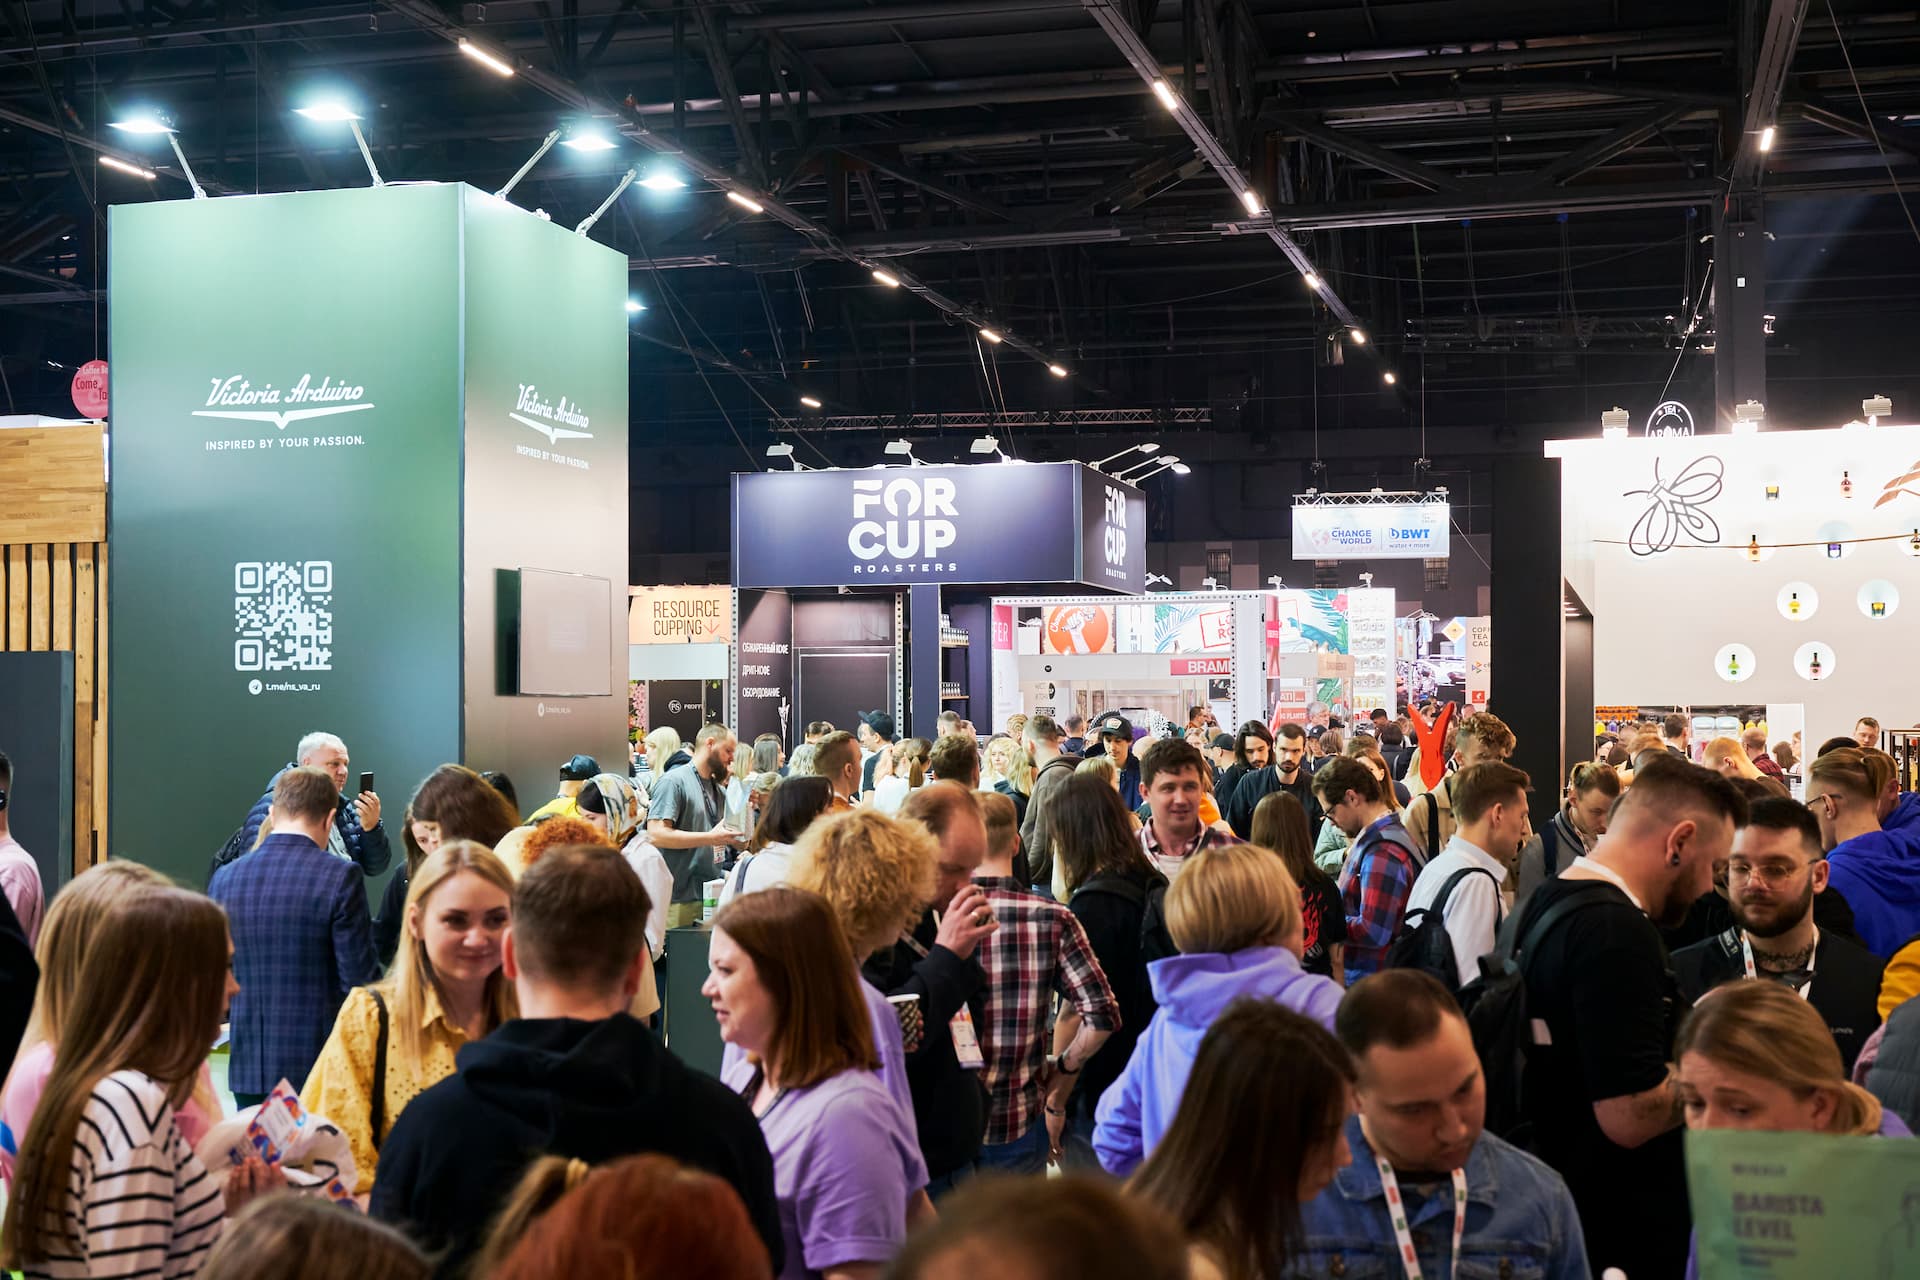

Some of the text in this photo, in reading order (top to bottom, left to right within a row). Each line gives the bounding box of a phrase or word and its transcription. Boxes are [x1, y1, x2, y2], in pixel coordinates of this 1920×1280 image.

[75, 378, 98, 390] Come
[205, 373, 364, 407] Victoria Arduino
[516, 383, 589, 429] Victoria Arduino
[205, 435, 365, 451] INSPIRED BY YOUR PASSION.
[516, 445, 541, 459] INSPIRED
[853, 477, 960, 519] FOR
[1105, 484, 1127, 529] FOR
[847, 519, 957, 560] CUP
[1332, 529, 1372, 538] CHANGE
[1340, 537, 1372, 545] WORLD
[1401, 528, 1430, 539] BWT
[1104, 525, 1127, 567] CUP
[853, 563, 957, 574] ROASTERS
[653, 600, 720, 618] RESOURCE
[653, 619, 702, 636] CUPPING
[265, 682, 321, 692] t.me/ns_va_ru
[742, 687, 781, 699] ОБОРУДОВАНИЕ
[1733, 1193, 1824, 1216] BARISTA
[1733, 1217, 1796, 1241] LEVEL
